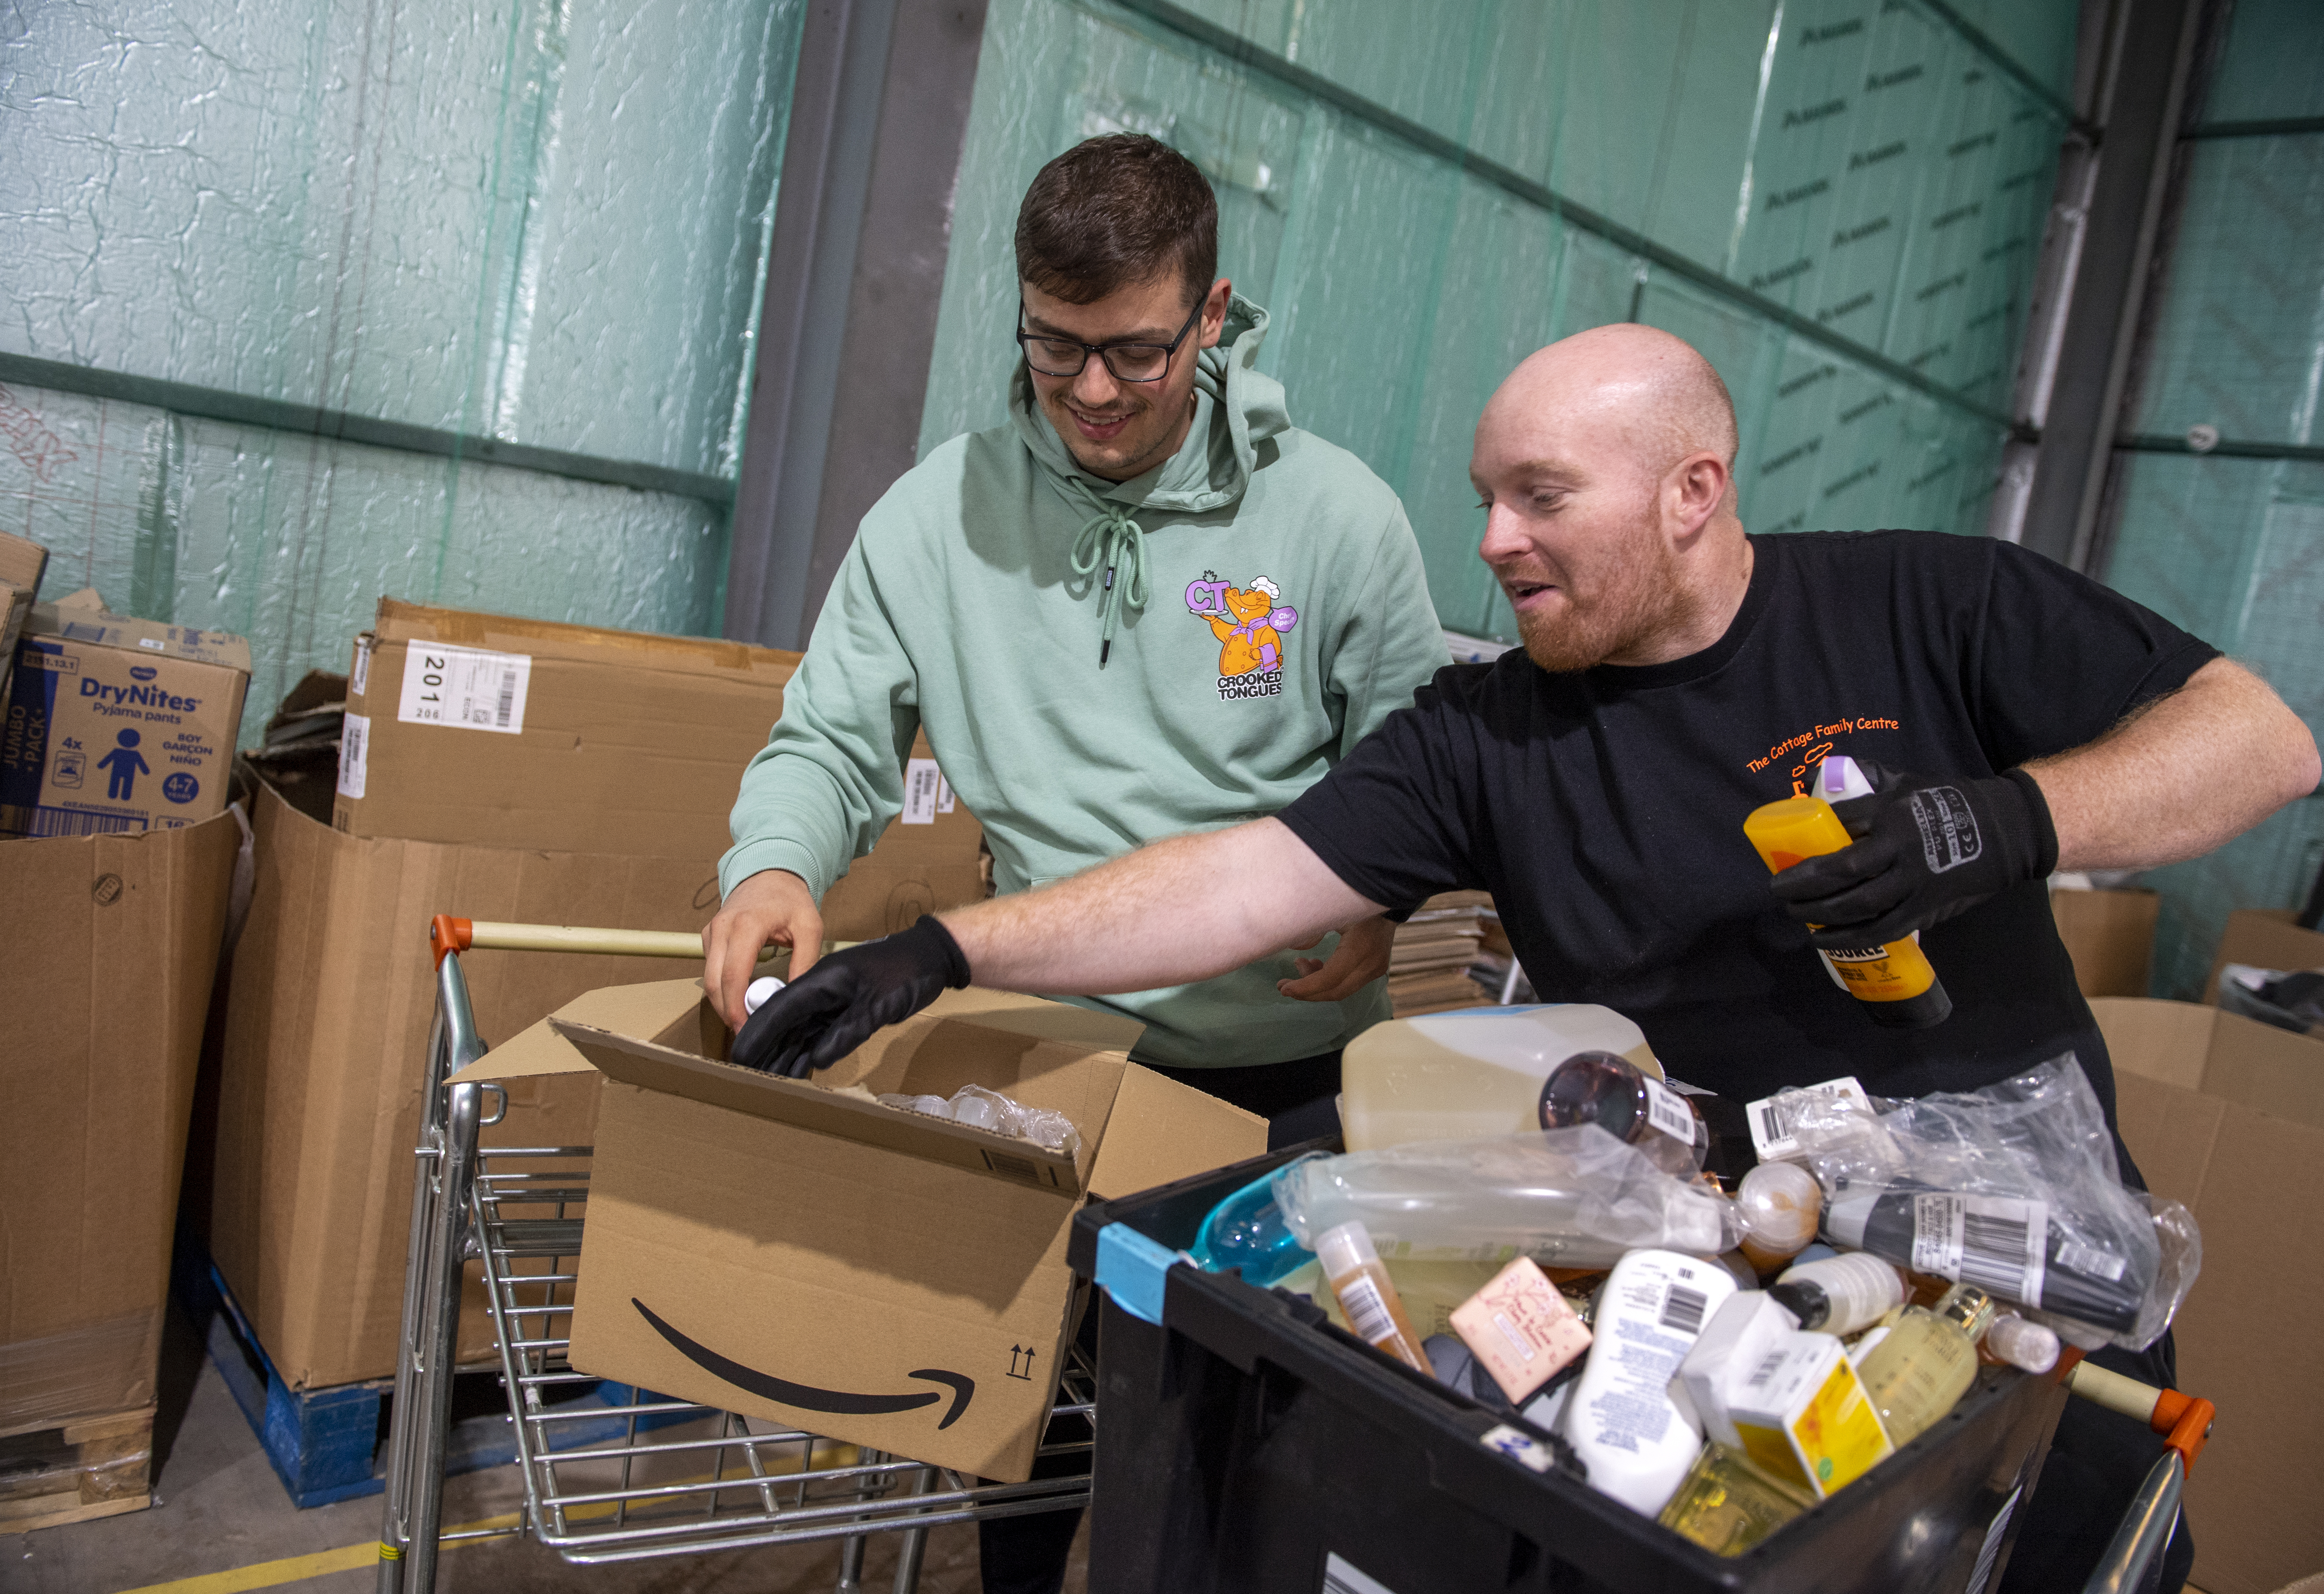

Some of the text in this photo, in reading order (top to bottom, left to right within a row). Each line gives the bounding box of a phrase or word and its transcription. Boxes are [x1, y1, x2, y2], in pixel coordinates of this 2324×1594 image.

[1185, 580, 1231, 612] CT
[421, 656, 444, 701] 201
[1217, 671, 1282, 689] CROOKED
[79, 676, 197, 713] DryNites
[1218, 683, 1282, 700] TONGUES
[93, 702, 181, 725] Pyjama pants
[4, 705, 26, 769] JUMBO
[24, 717, 45, 762] PACK
[62, 737, 82, 750] 4x
[178, 733, 202, 743] BOY
[1746, 718, 1899, 773] The Cottage Family Centre
[163, 741, 213, 756] GARÇON
[170, 754, 202, 767] NIÑO
[169, 777, 194, 793] 4-7
[1946, 826, 1955, 840] 10
